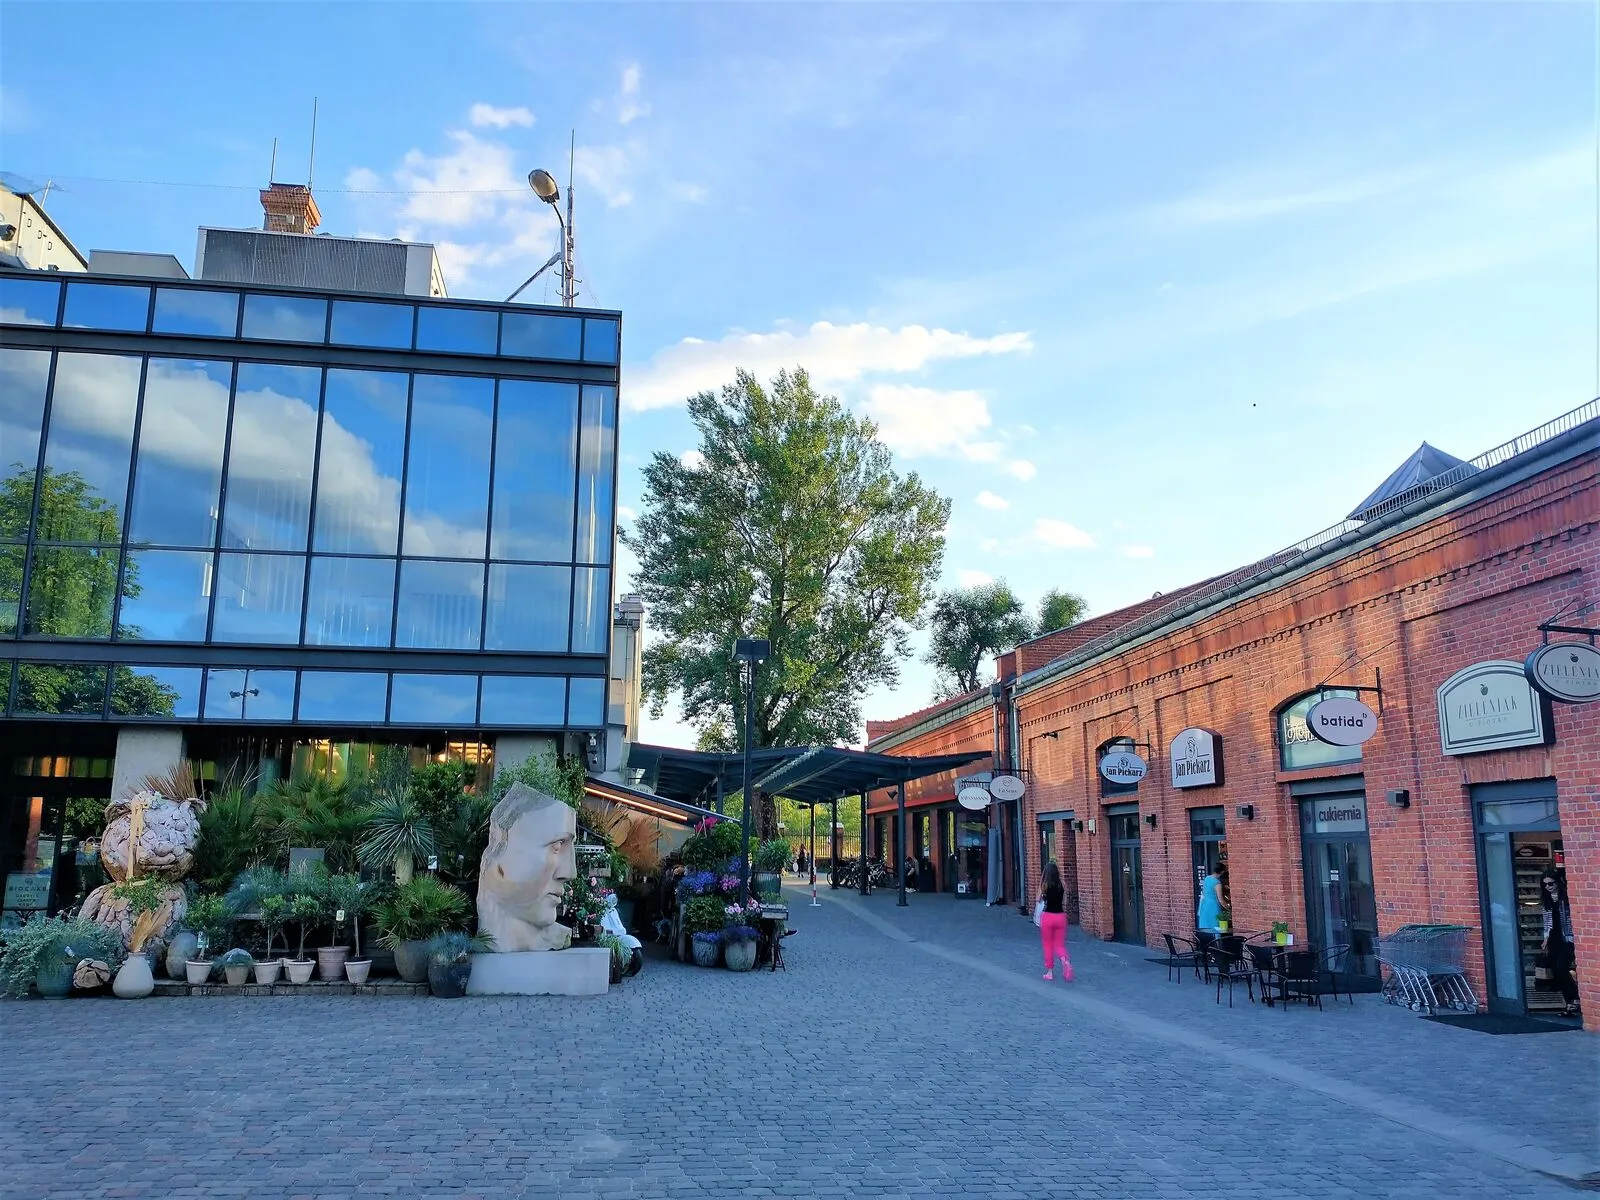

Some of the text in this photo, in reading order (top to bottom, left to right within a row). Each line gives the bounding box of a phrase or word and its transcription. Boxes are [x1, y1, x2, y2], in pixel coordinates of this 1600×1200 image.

[1321, 714, 1364, 728] batida
[1106, 767, 1143, 777] Jan Piekarz
[1175, 759, 1211, 778] Jan Piekarz
[1318, 804, 1362, 822] cukiernia
